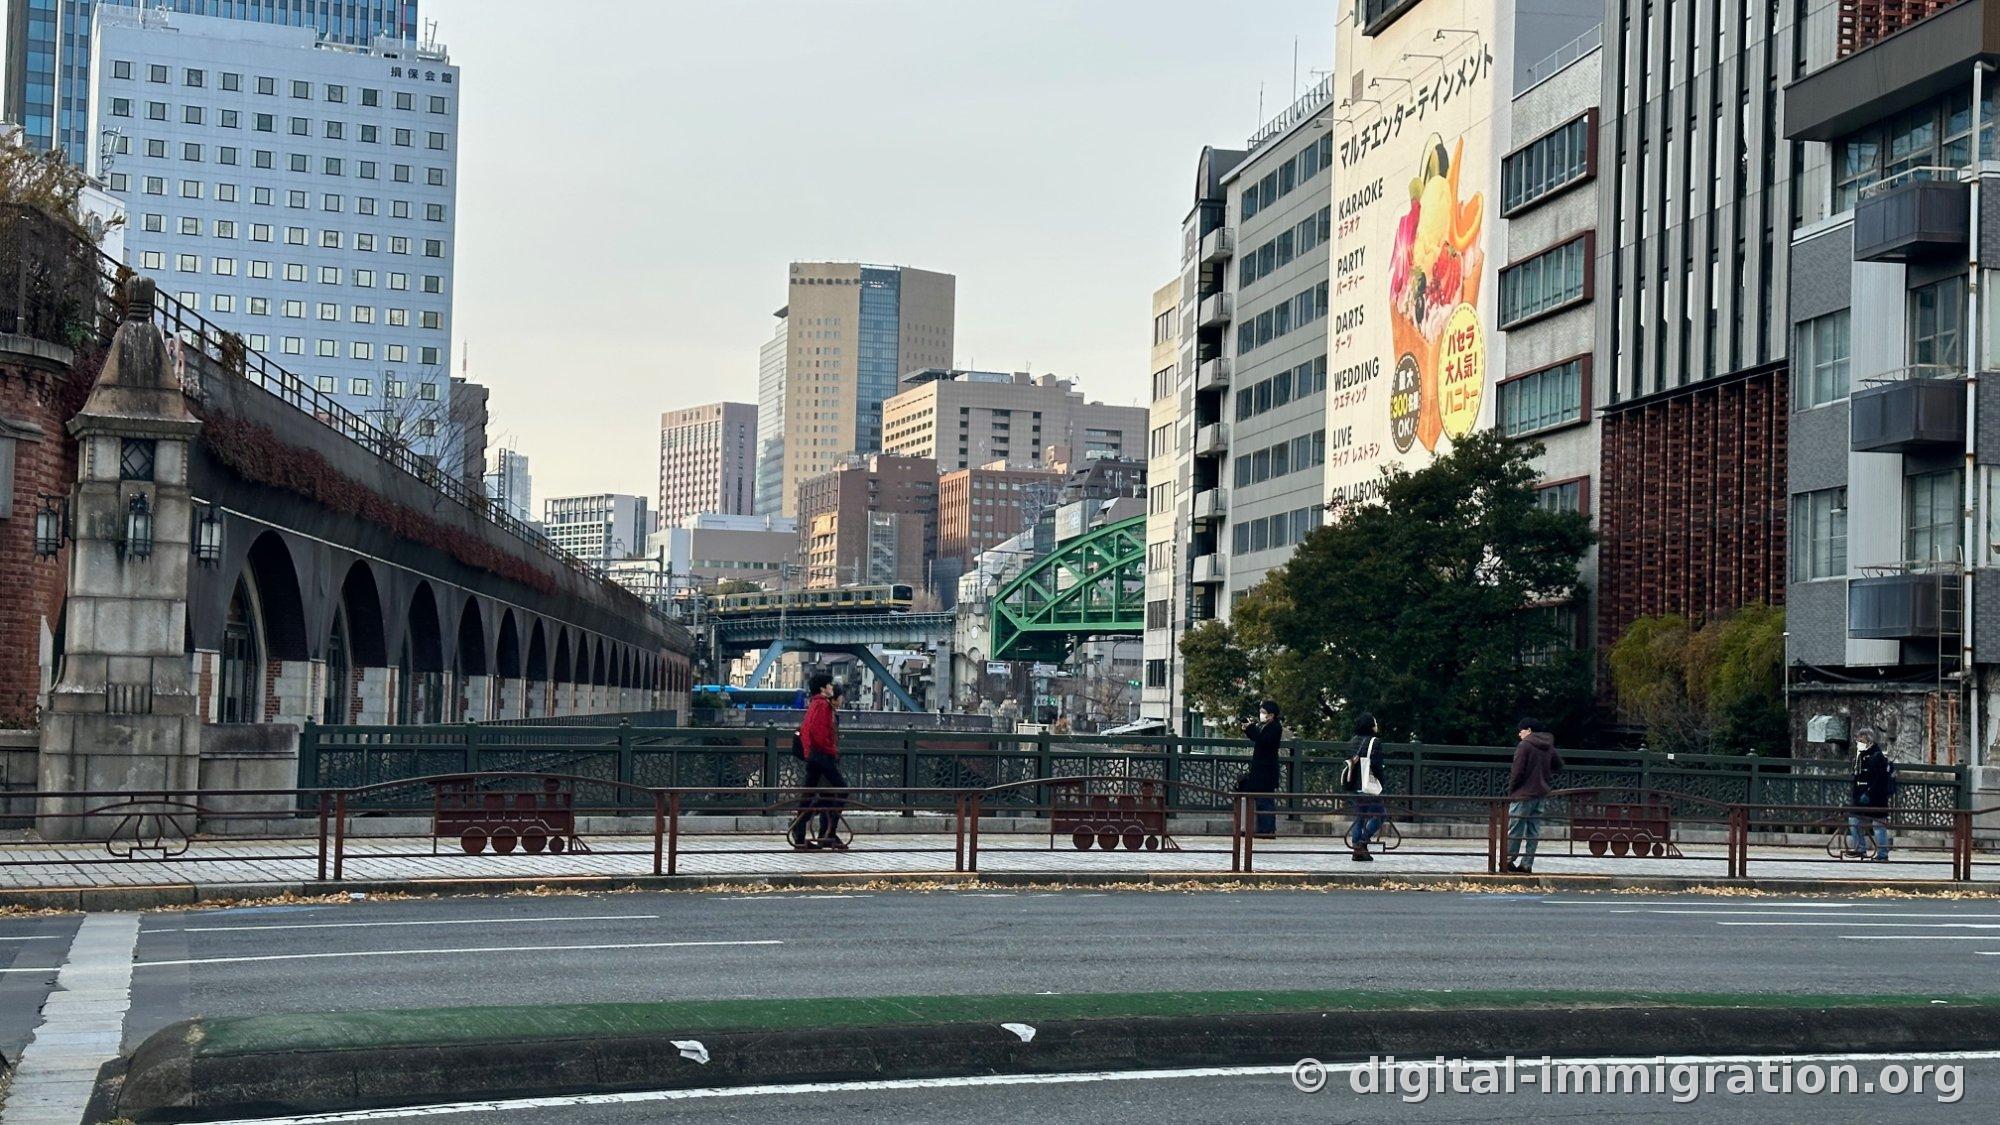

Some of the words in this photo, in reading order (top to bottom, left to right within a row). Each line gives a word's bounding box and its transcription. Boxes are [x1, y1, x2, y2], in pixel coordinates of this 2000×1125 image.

[390, 66, 453, 84] 損保会館
[1340, 43, 1493, 170] マルチエンターテインメント
[1338, 177, 1383, 221] KARAOKE
[1338, 215, 1360, 239] カラオケ
[1337, 245, 1366, 278] PARTY
[1336, 275, 1365, 296] パーティー
[1335, 304, 1364, 335] DARTS
[1334, 356, 1379, 392] WEDDING
[1333, 425, 1352, 450] LIVE
[1397, 417, 1414, 438] OK!
[1352, 443, 1381, 464] レストラン
